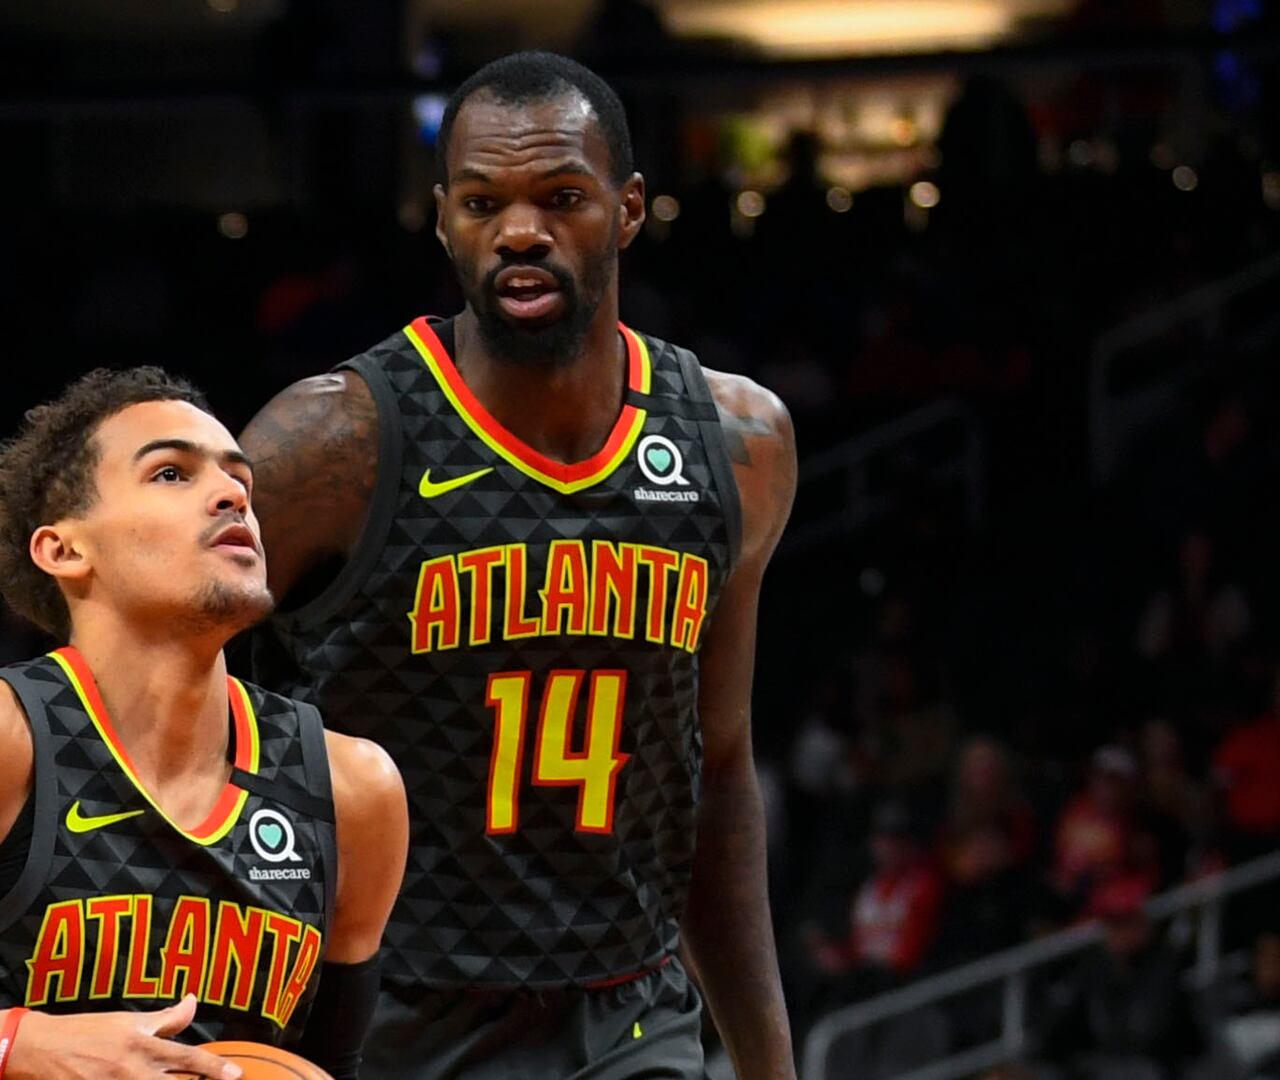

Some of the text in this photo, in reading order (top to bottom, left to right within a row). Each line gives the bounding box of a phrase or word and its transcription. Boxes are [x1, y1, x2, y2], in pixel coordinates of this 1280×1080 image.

[634, 486, 700, 502] sharecare
[407, 539, 709, 655] ATLANTA
[484, 668, 632, 836] 14
[248, 866, 311, 880] sharecare
[25, 894, 322, 1030] ATLANTA
